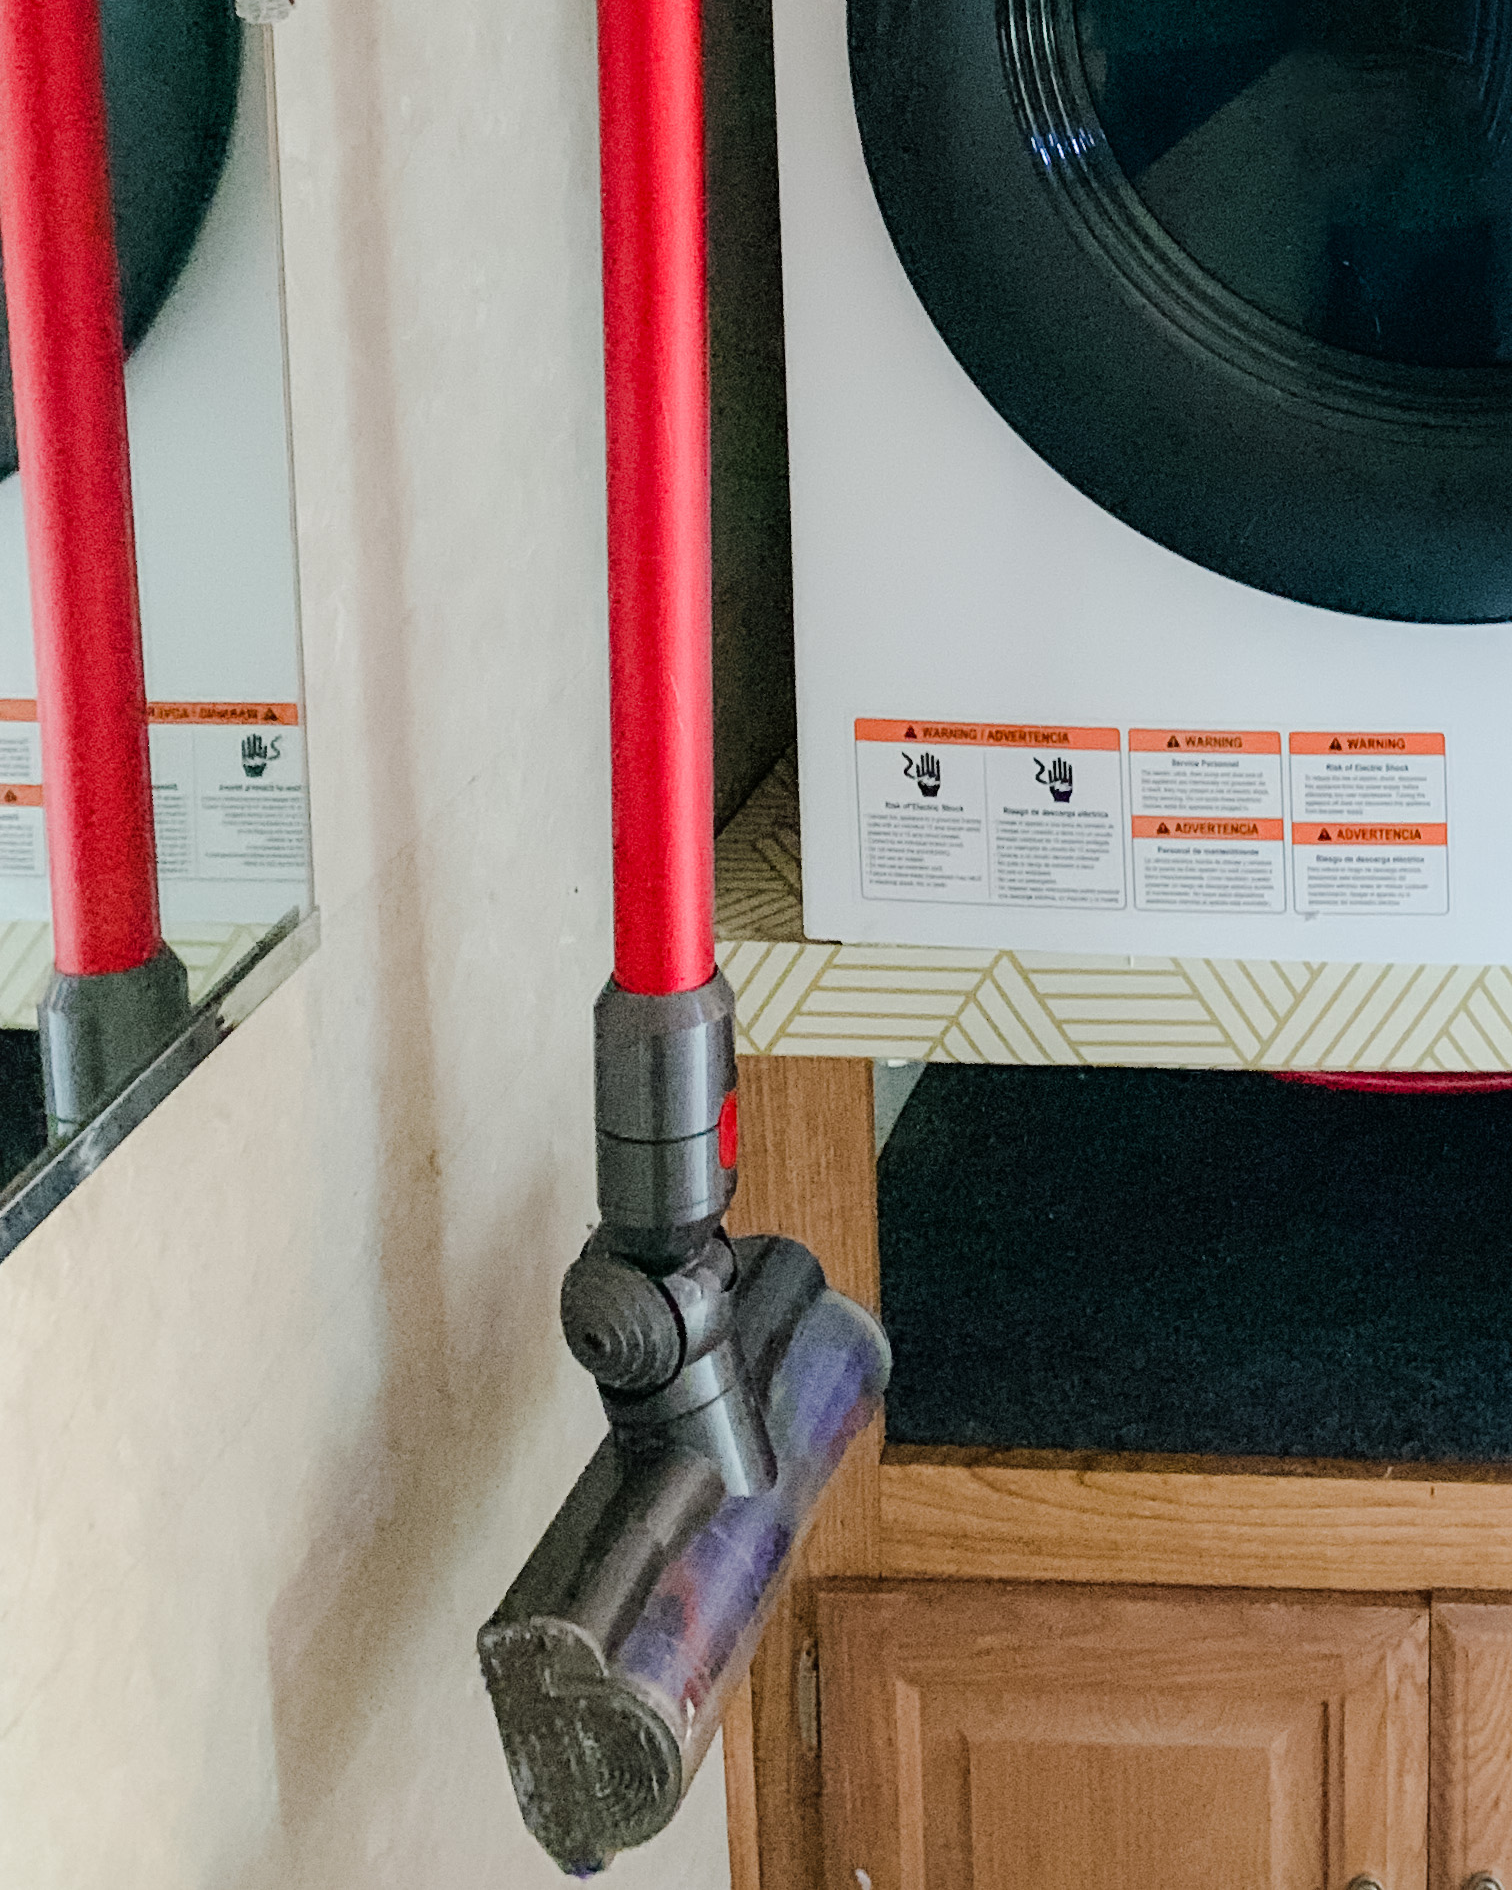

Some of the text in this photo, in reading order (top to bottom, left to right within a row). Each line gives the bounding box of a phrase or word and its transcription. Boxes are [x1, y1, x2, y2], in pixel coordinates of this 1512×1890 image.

[922, 726, 978, 742] WARNING
[986, 728, 1071, 745] ADVERTENCIA
[1184, 735, 1243, 749] WARNING
[1346, 737, 1406, 750] WARNING
[1174, 821, 1259, 835] ADVERTENCIA
[1336, 827, 1422, 841] ADVERTENCIA
